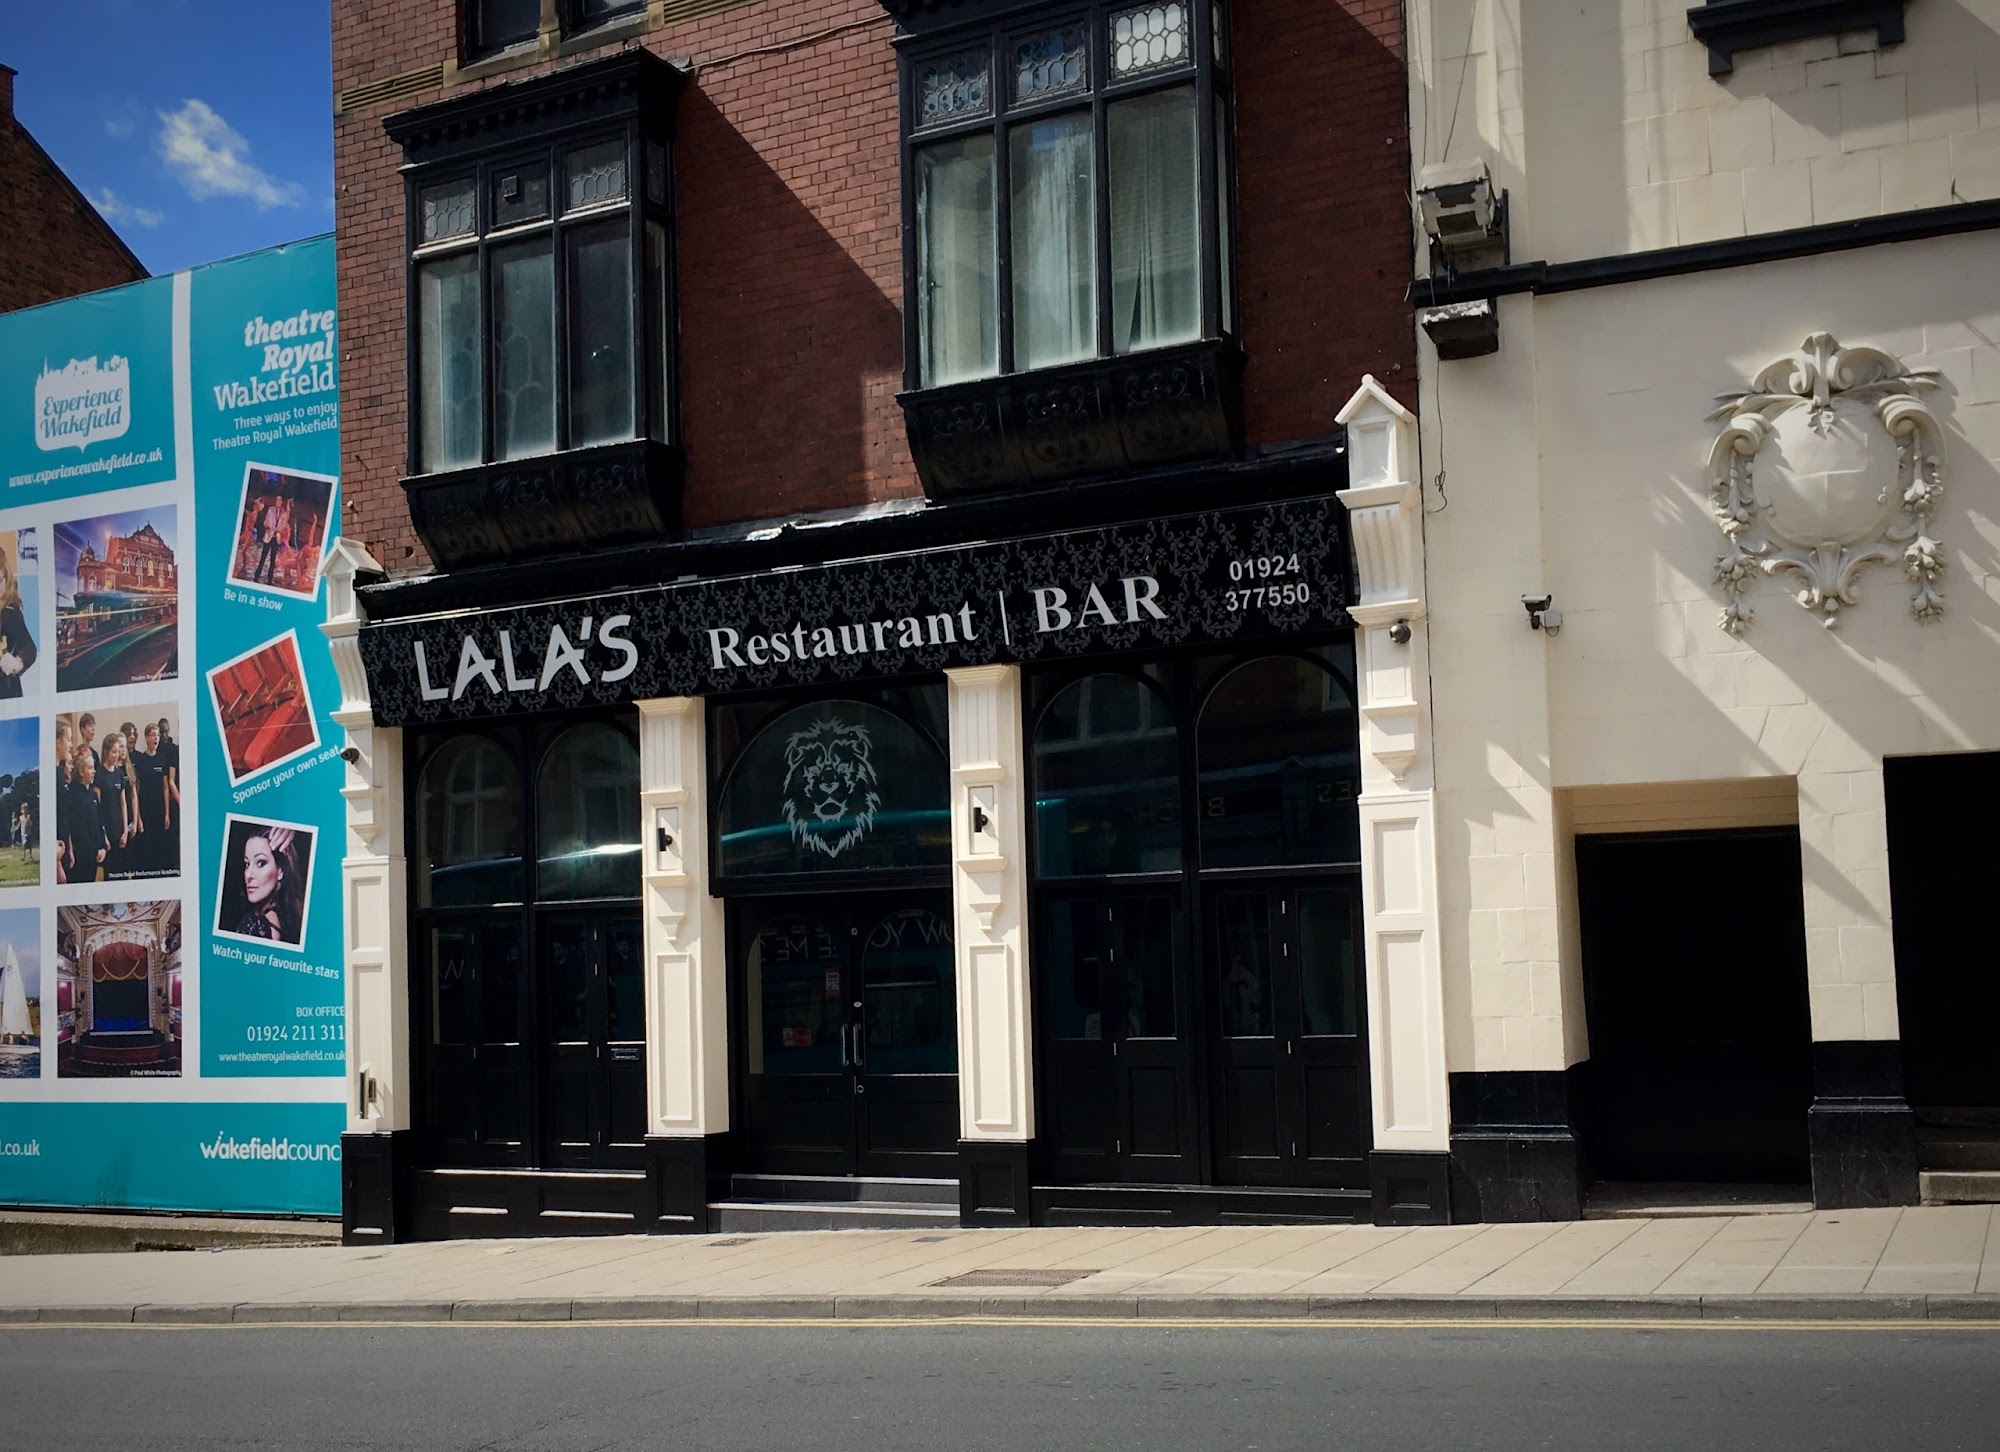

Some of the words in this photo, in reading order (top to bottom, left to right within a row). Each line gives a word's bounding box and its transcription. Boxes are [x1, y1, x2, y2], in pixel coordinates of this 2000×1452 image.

[244, 309, 336, 347] theatre
[261, 331, 335, 374] Royal
[213, 361, 336, 411] Wakefield
[43, 388, 123, 419] Experience
[234, 416, 262, 430] Three
[264, 410, 291, 424] ways
[293, 407, 304, 419] to
[307, 402, 337, 417] enjoy
[40, 405, 122, 438] Wakefield
[213, 434, 251, 450] Theatre
[253, 426, 282, 443] Royal
[285, 416, 337, 437] Wakefield
[9, 447, 163, 487] www.experiencewakefield.co.uk
[1229, 553, 1300, 582] 01924
[224, 588, 236, 601] Be
[238, 591, 248, 604] in
[249, 595, 255, 606] a
[257, 596, 283, 611] show
[1225, 582, 1310, 612] 377550
[413, 614, 639, 702] LALA'S
[705, 600, 979, 670] Restaurant
[1032, 575, 1169, 633] BAR
[233, 779, 271, 804] Sponsor
[273, 767, 295, 788] your
[297, 757, 318, 773] own
[318, 744, 340, 763] seat
[212, 943, 242, 960] Watch
[244, 952, 267, 965] your
[269, 954, 313, 974] favourite
[315, 965, 340, 979] stars
[296, 1007, 314, 1018] BOX
[315, 1006, 345, 1017] OFFICE
[247, 1025, 288, 1042] 01924
[292, 1025, 315, 1041] 211
[320, 1024, 345, 1041] 311
[219, 1050, 346, 1064] www.theatreroyalwakefield.co.uk
[200, 1130, 341, 1161] wakefieldcounc
